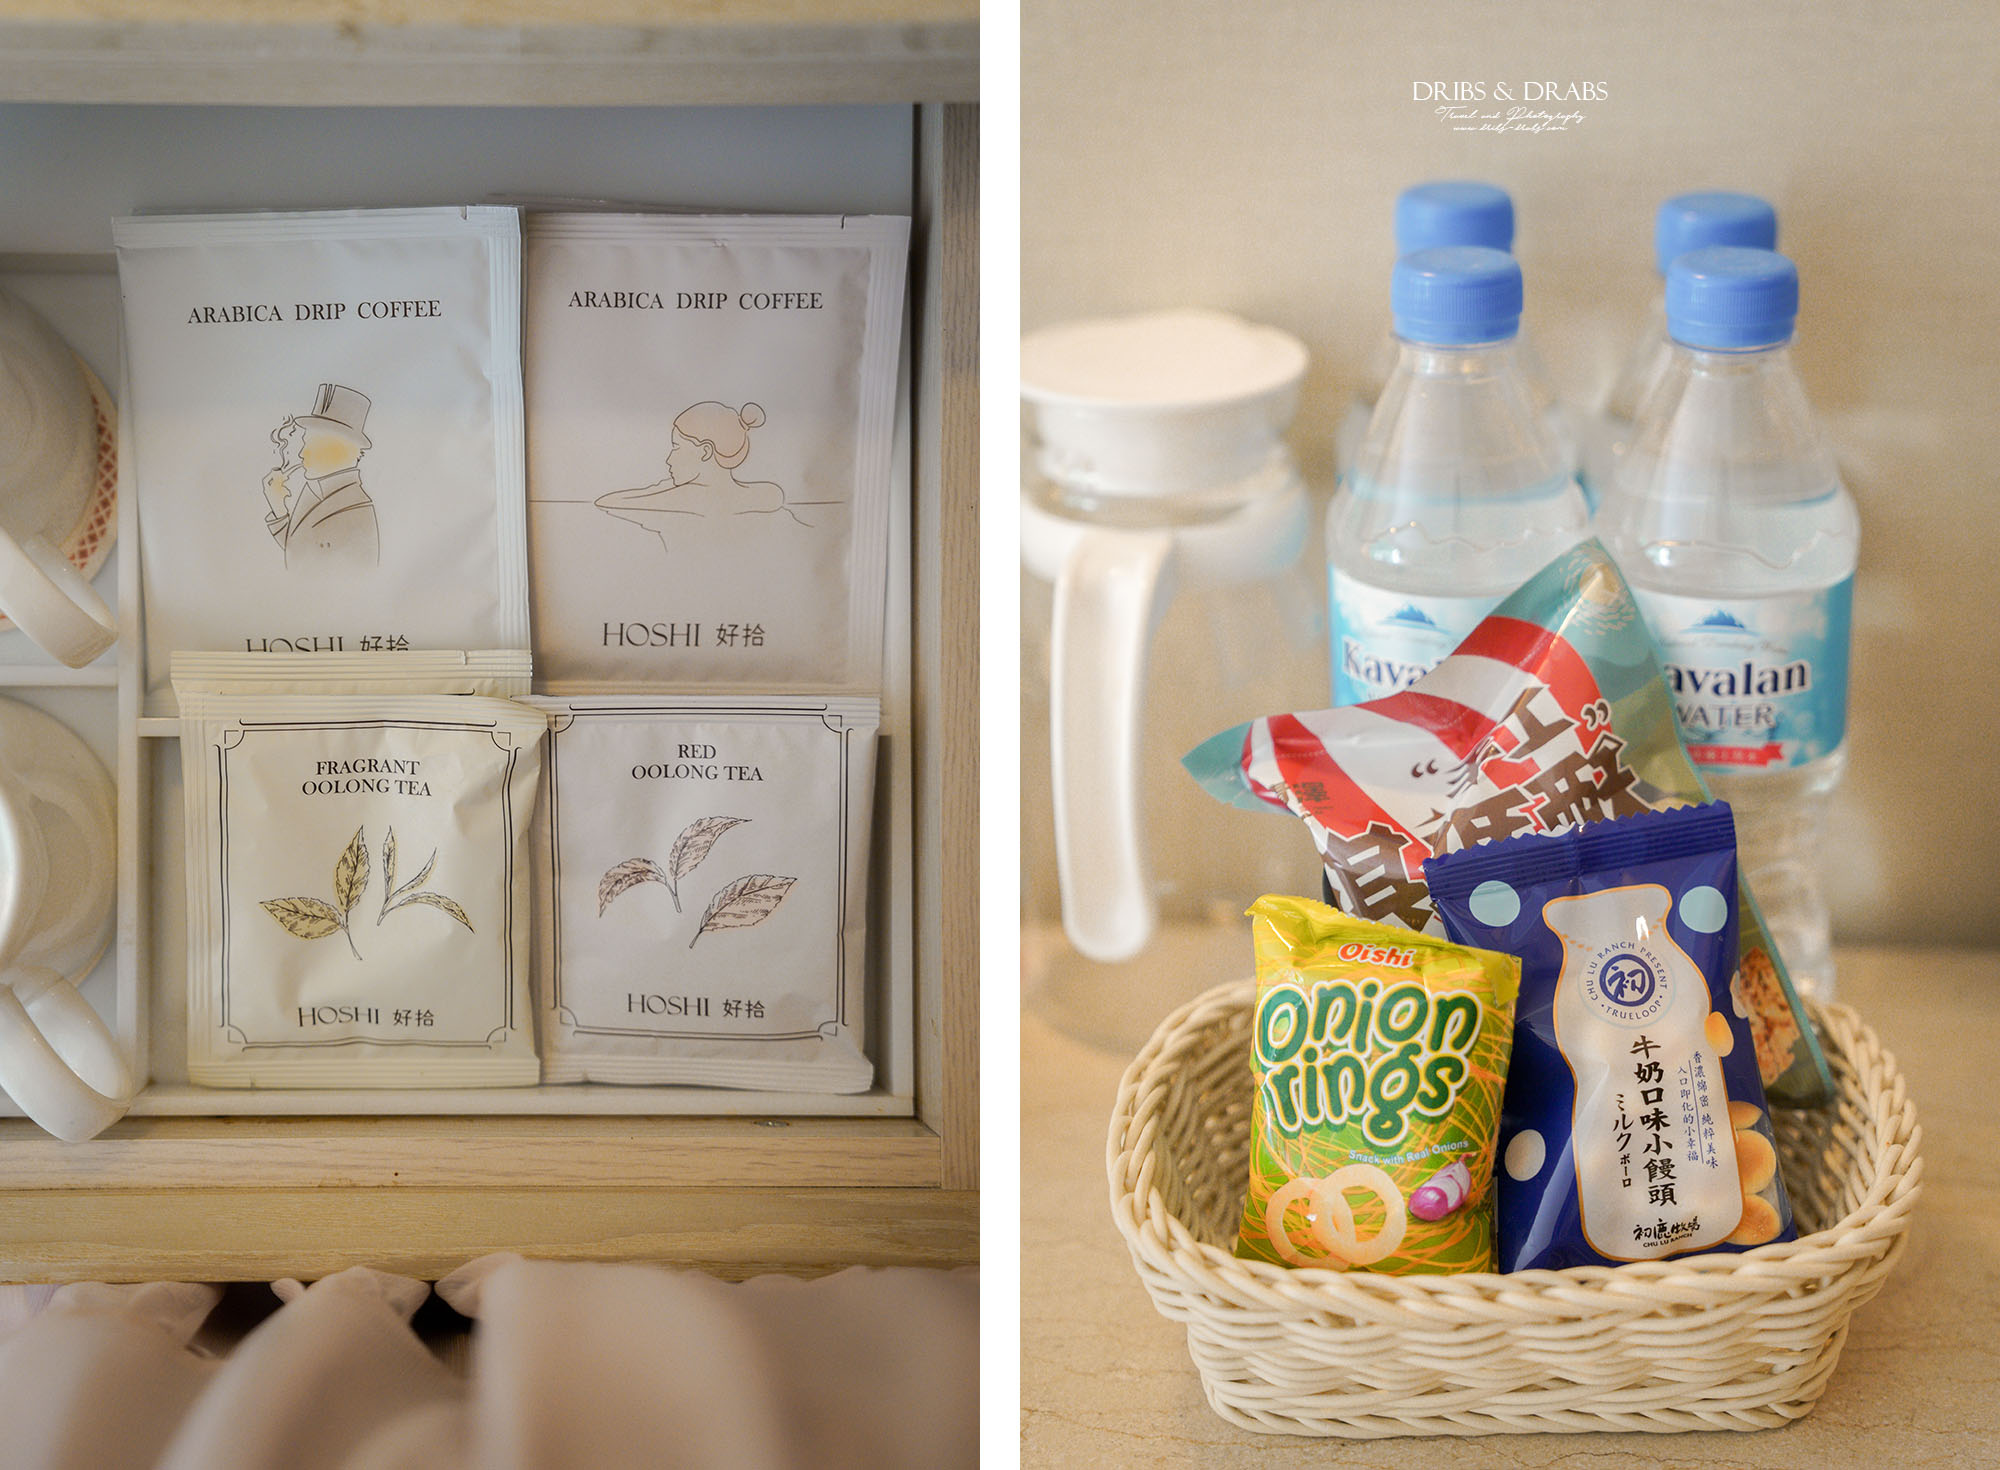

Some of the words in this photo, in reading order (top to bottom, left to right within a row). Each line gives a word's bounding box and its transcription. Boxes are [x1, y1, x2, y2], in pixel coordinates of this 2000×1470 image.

[187, 303, 283, 324] ARABICA
[294, 303, 347, 322] DRIP
[357, 300, 442, 319] COFFEE
[568, 291, 665, 310] ARABICA
[677, 292, 728, 310] DRIP
[739, 292, 824, 310] COFFEE
[603, 622, 701, 648] HOSHI
[716, 622, 766, 649] 好拾
[1344, 640, 1443, 687] Kava
[1664, 661, 1808, 697] avalan
[677, 743, 717, 760] RED
[316, 758, 420, 776] FRAGRANT
[631, 763, 718, 781] OOLONG
[724, 765, 764, 782] TEA
[302, 778, 390, 796] OOLONG
[394, 779, 432, 797] TEA
[1338, 943, 1416, 968] Oishi
[1597, 941, 1635, 959] RANCH
[1587, 961, 1598, 975] LU
[1640, 946, 1668, 990] PRESENT
[1586, 980, 1599, 1001] CHU
[298, 1006, 380, 1028] HOSHI
[393, 1009, 435, 1028] 好拾
[627, 993, 709, 1018] HOSHI
[723, 998, 766, 1019] 好拾
[1606, 999, 1662, 1020] TRUELOOP
[1267, 1040, 1470, 1147] rings
[1630, 1035, 1678, 1207] 牛奶口味小饅頭
[1677, 1066, 1699, 1162] 入口即化的小幸福
[1349, 1149, 1380, 1165] Snack
[1383, 1153, 1405, 1165] with
[1406, 1147, 1430, 1162] Real
[1432, 1140, 1469, 1155] Onions
[1670, 1232, 1693, 1243] RANCH
